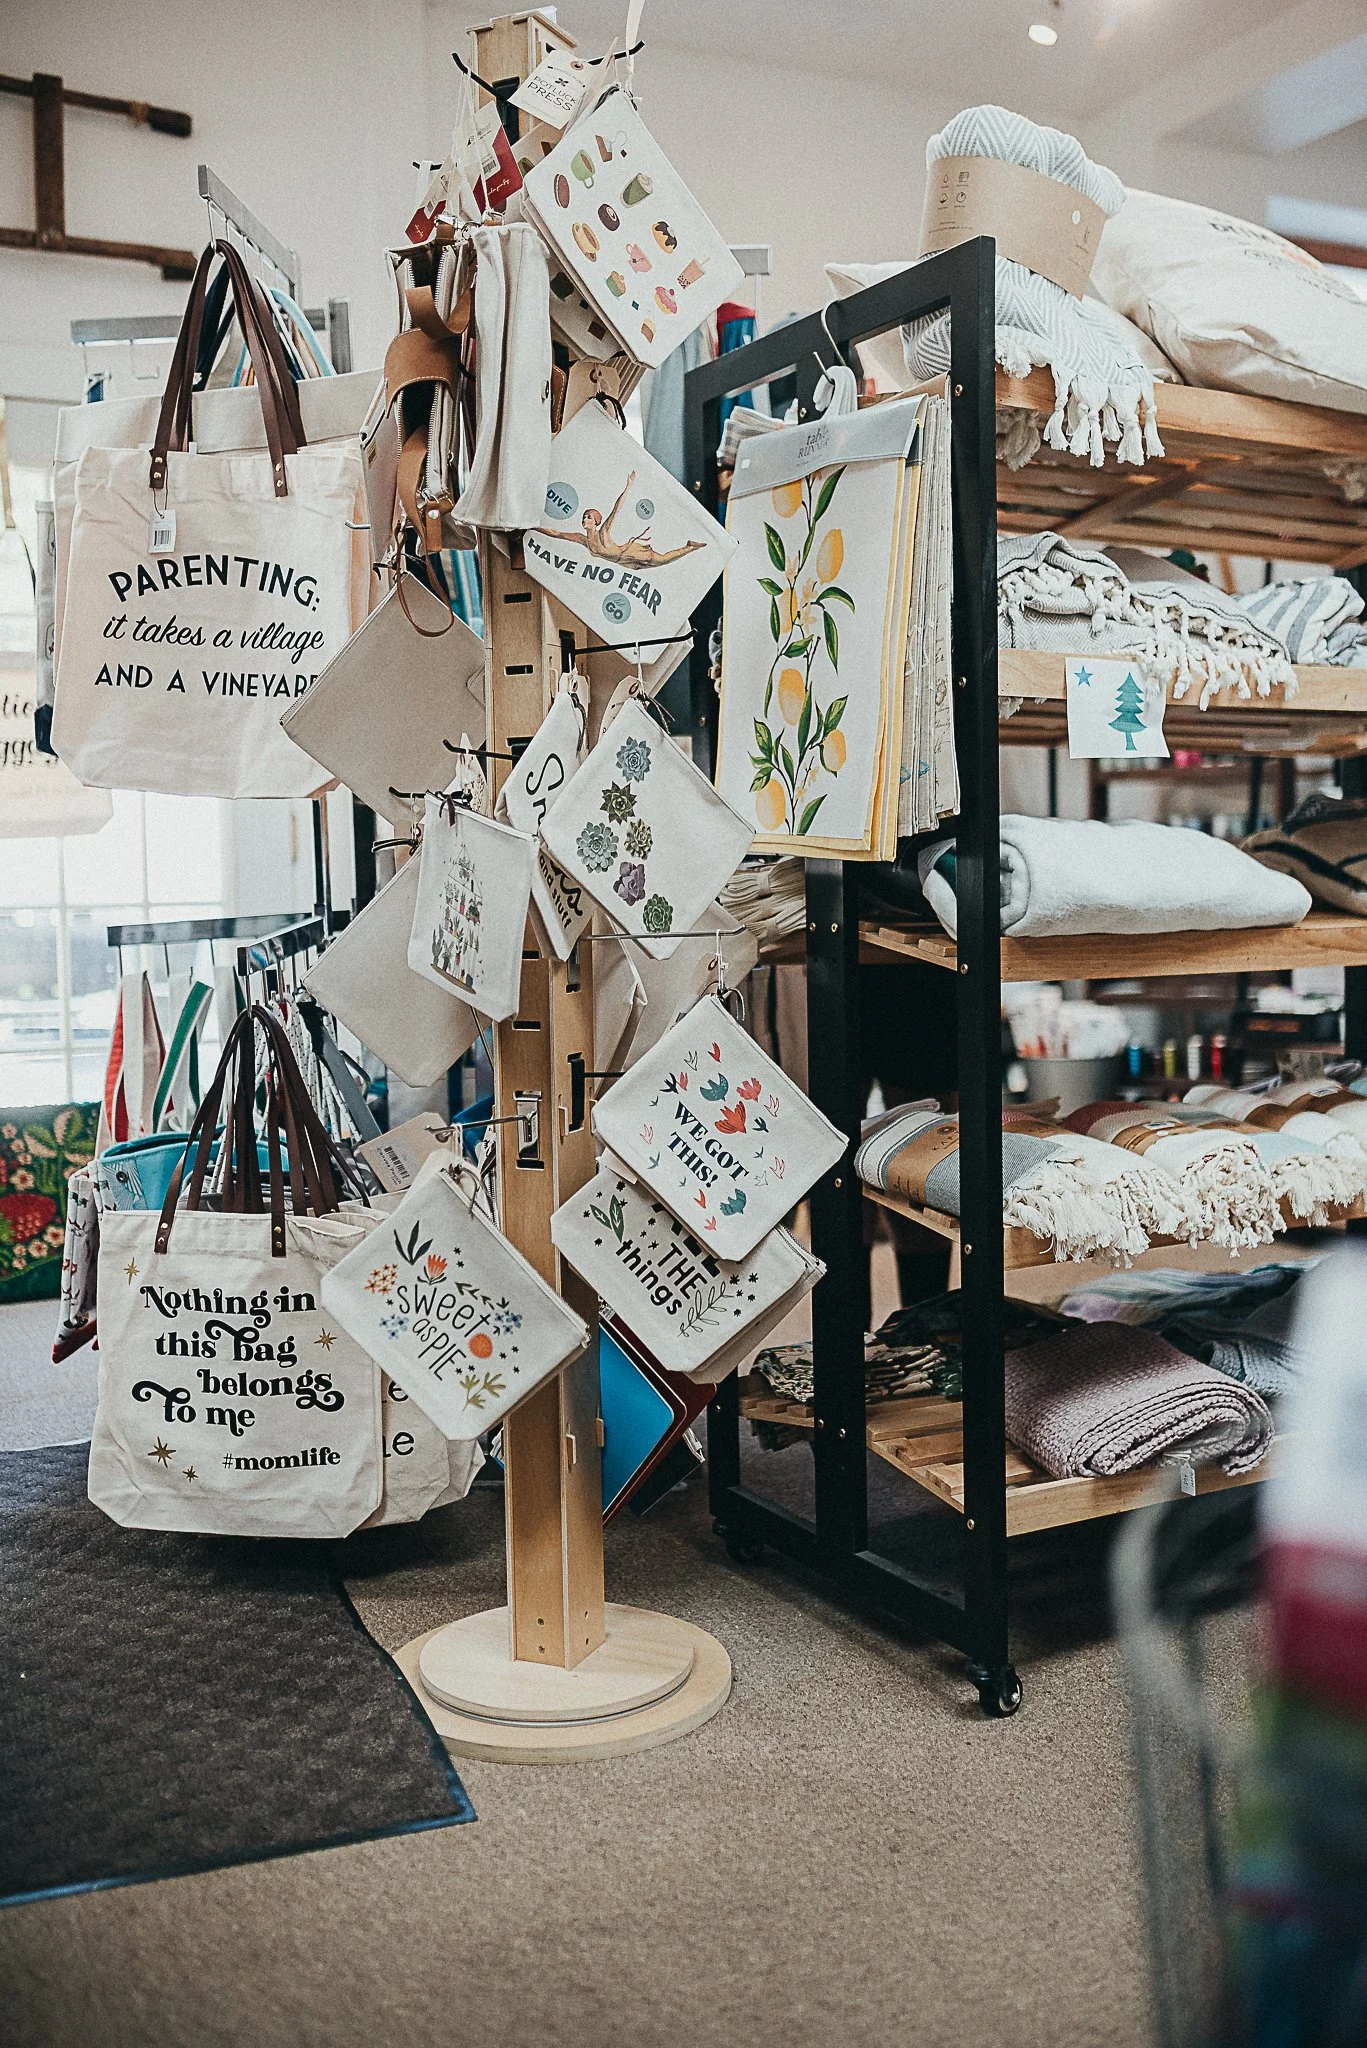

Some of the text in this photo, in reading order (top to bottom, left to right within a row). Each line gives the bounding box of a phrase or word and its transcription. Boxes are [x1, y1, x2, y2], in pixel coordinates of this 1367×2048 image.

[527, 82, 573, 111] PRESS
[533, 75, 576, 104] POTLUCK
[546, 489, 572, 514] DIVE
[108, 554, 321, 612] PARENTING:
[527, 537, 662, 617] HAVE NO FEAR
[605, 602, 624, 620] GO
[103, 613, 325, 665] it takes a village
[94, 662, 153, 688] AND
[166, 669, 186, 693] A
[551, 888, 572, 929] stuff
[667, 1132, 719, 1188] THIS!
[674, 1101, 749, 1181] WE GOT
[615, 1239, 683, 1315] things
[657, 1242, 708, 1300] THE
[140, 1285, 317, 1329] Nothing in
[396, 1284, 491, 1338] sweet
[154, 1319, 298, 1368] this bag
[418, 1332, 467, 1381] PIE
[131, 1380, 255, 1437] to me
[196, 1368, 345, 1412] belongs
[222, 1446, 341, 1471] #momlife
